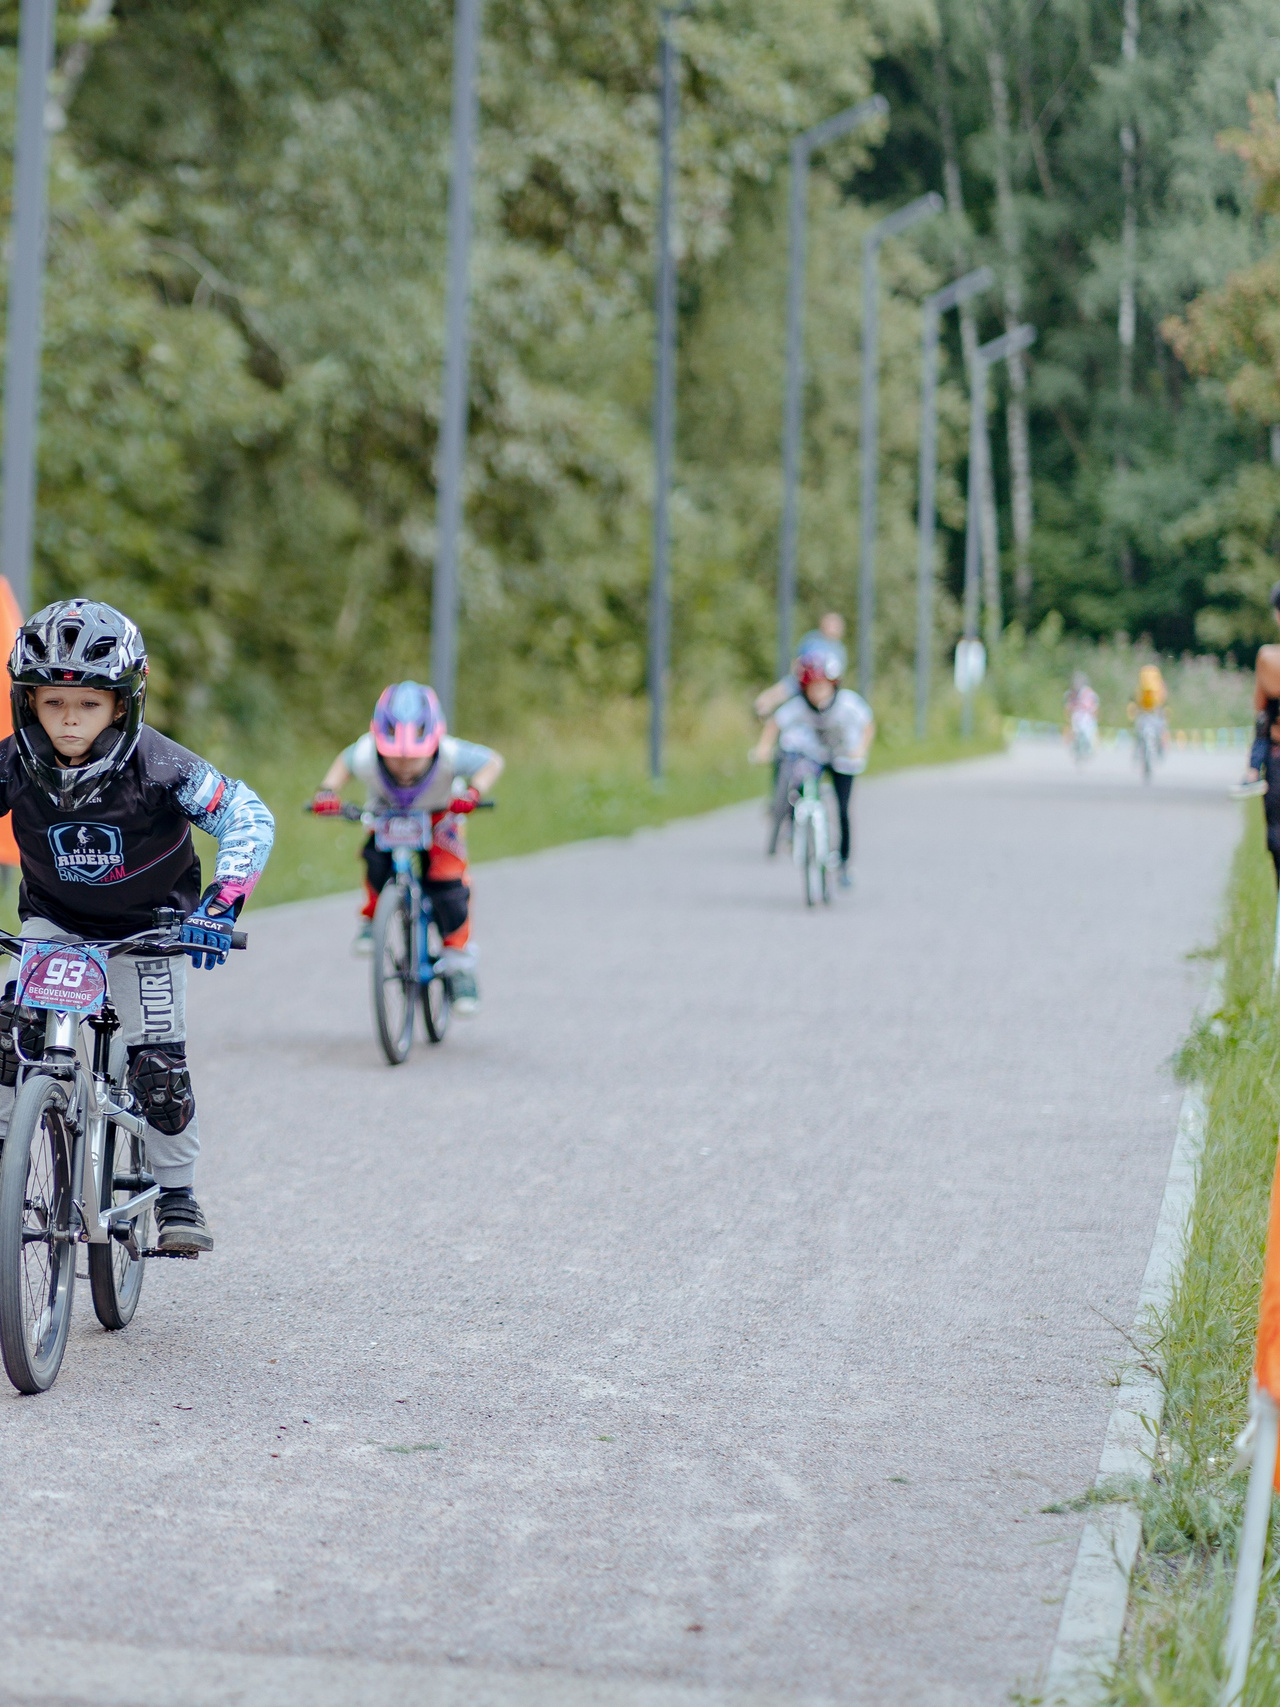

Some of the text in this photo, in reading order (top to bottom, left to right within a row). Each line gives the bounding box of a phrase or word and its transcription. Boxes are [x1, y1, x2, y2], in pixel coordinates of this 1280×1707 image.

[57, 854, 121, 867] RIDERS
[187, 918, 224, 931] JETCAT
[43, 958, 87, 988] 93
[28, 986, 92, 1001] BEGOVELVIDNOE
